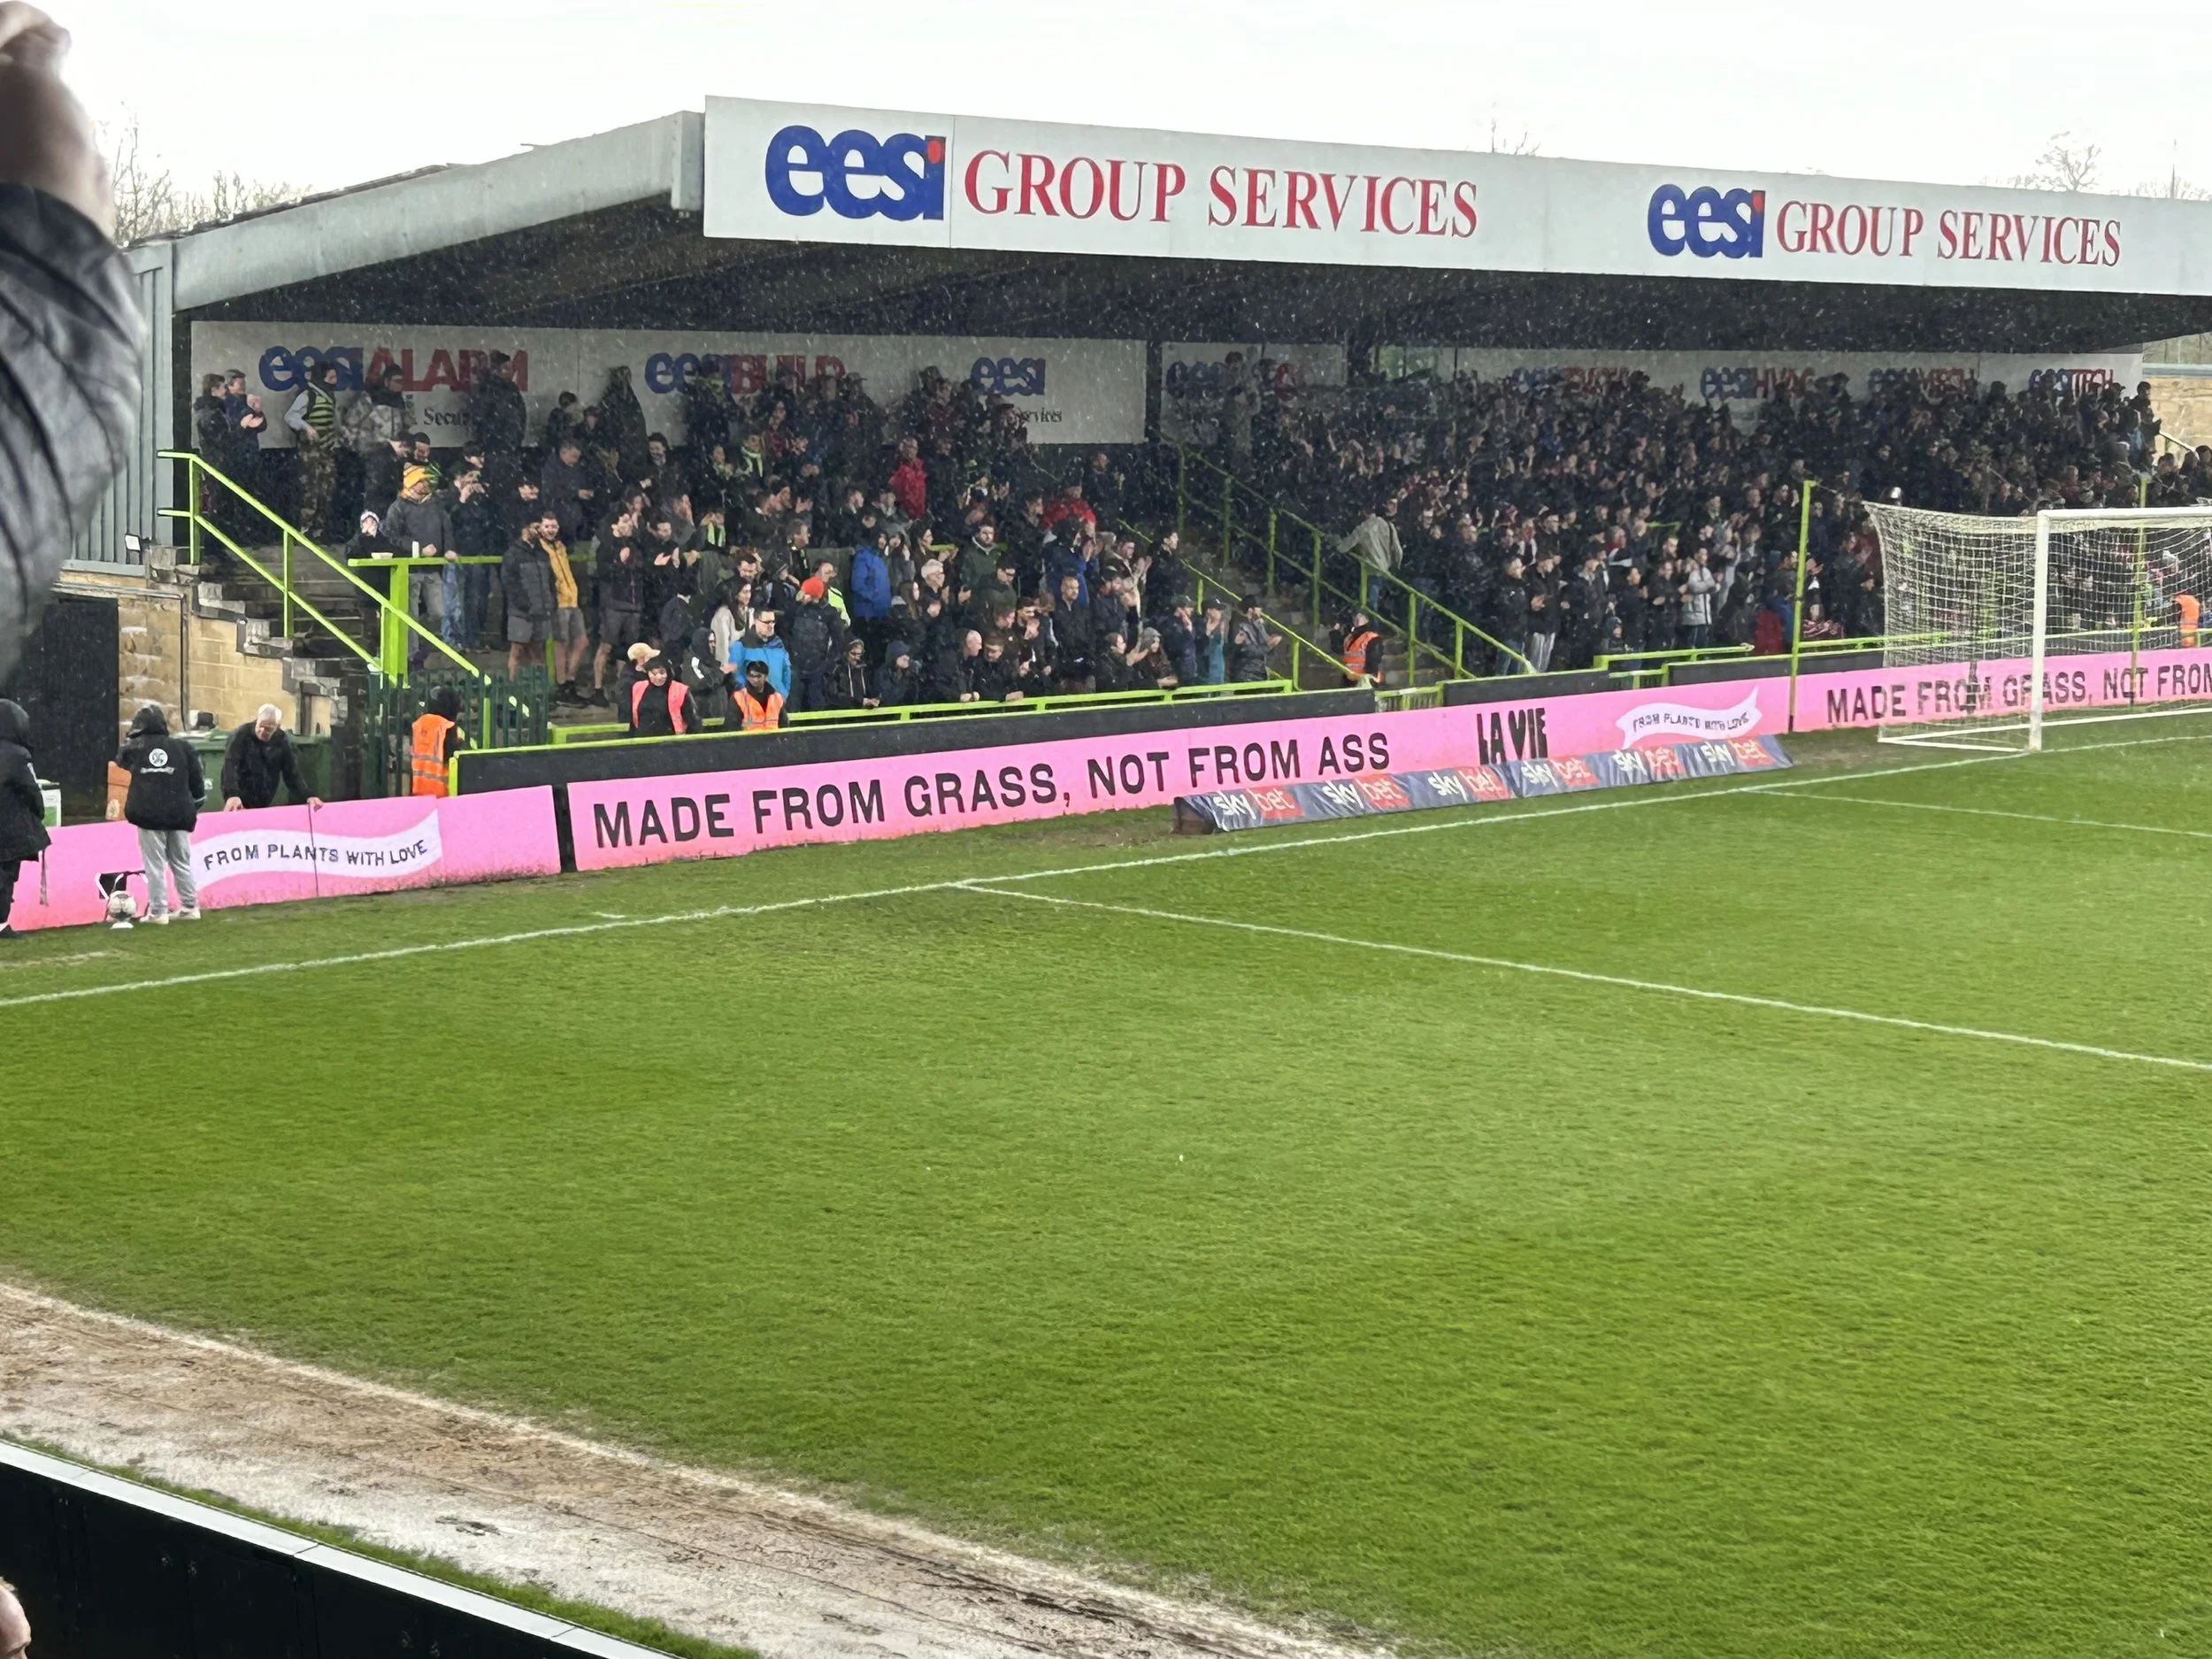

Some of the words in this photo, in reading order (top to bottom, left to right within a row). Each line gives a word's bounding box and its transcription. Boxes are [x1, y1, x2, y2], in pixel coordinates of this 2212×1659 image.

[765, 125, 945, 220] eesi
[964, 149, 1185, 222] GROUP
[1208, 165, 1479, 238] SERVICES
[1647, 183, 1765, 258] eesi
[1777, 200, 1924, 257] GROUP
[1937, 209, 2121, 266] SERVICES
[1827, 685, 1906, 724] MADE
[2103, 667, 2148, 701] NOT
[594, 793, 734, 848] MADE
[752, 778, 885, 833] FROM
[903, 762, 1071, 818] GRASS,
[1087, 750, 1171, 799] NOT
[1188, 742, 1301, 787] FROM
[1317, 732, 1390, 775] ASS
[1427, 772, 1468, 802] sky
[1521, 760, 1560, 789] sky
[1213, 790, 1256, 820] sky
[1322, 780, 1364, 809] sky
[204, 844, 259, 871] FROM
[267, 844, 339, 863] PLANTS
[346, 850, 384, 866] WITH
[389, 840, 427, 864] LOVE
